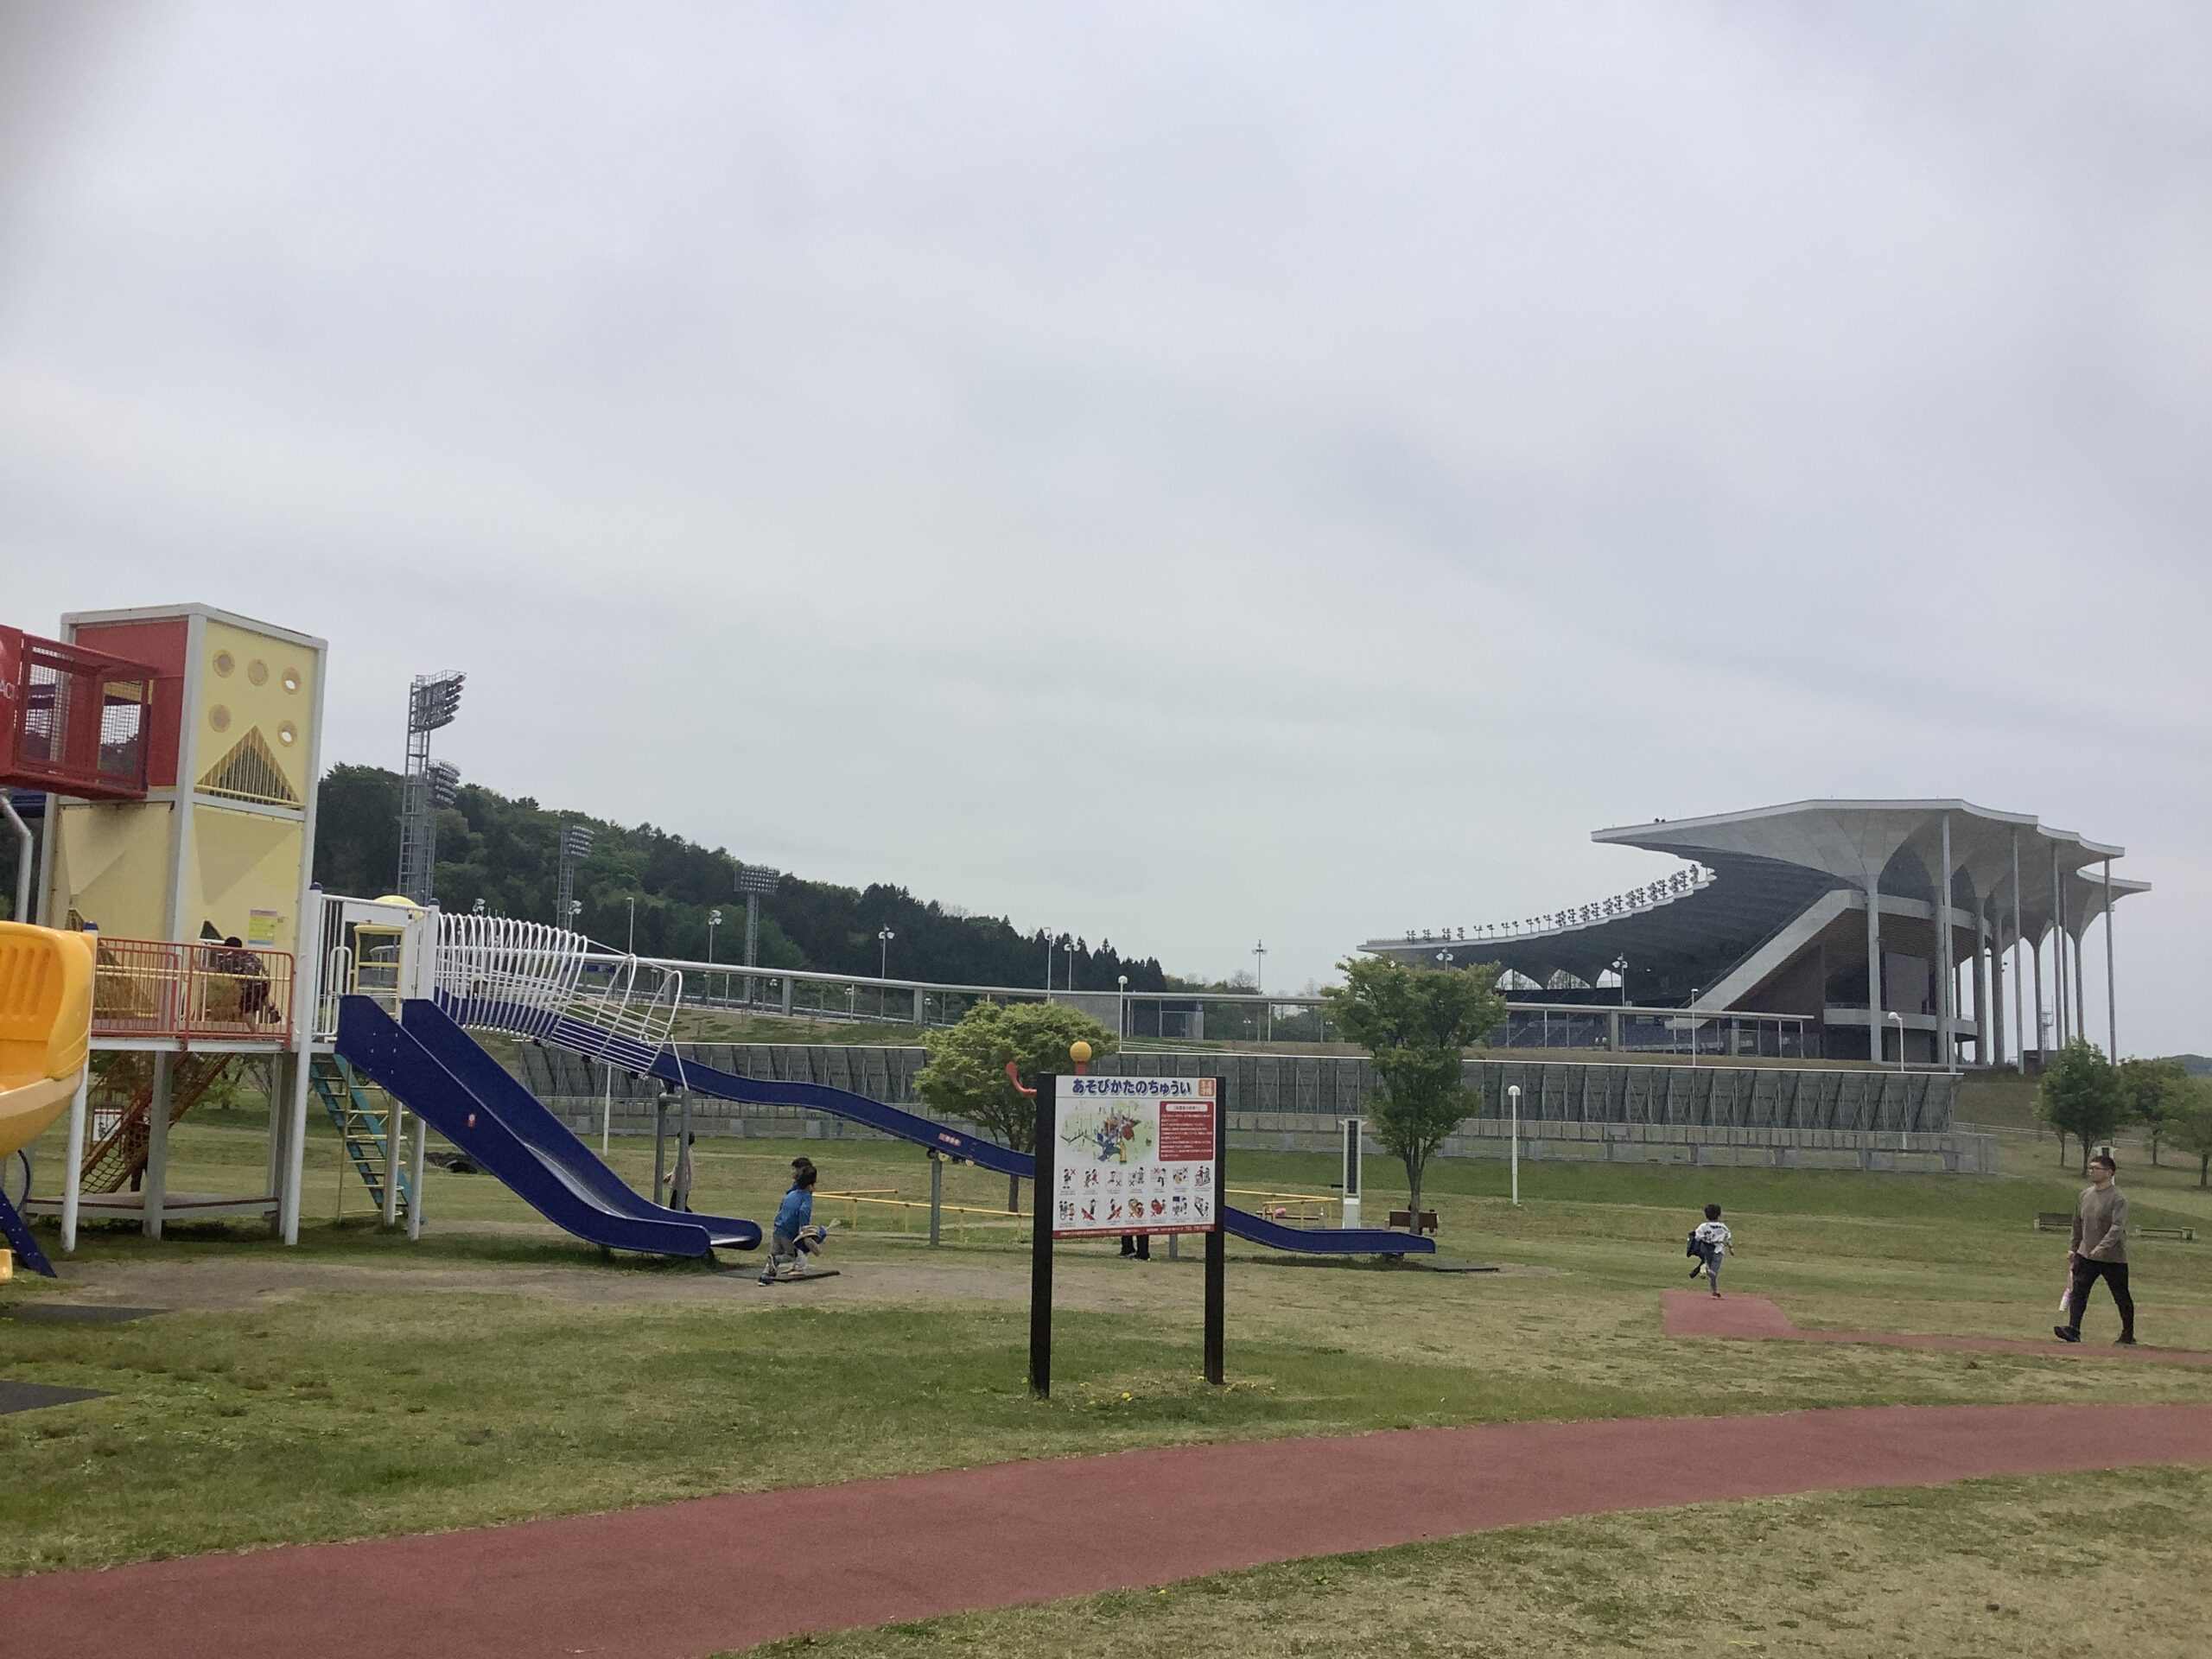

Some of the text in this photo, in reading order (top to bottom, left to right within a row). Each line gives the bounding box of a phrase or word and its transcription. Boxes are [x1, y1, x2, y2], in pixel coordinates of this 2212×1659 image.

[1072, 1078, 1192, 1096] あそびかたのちゅうい
